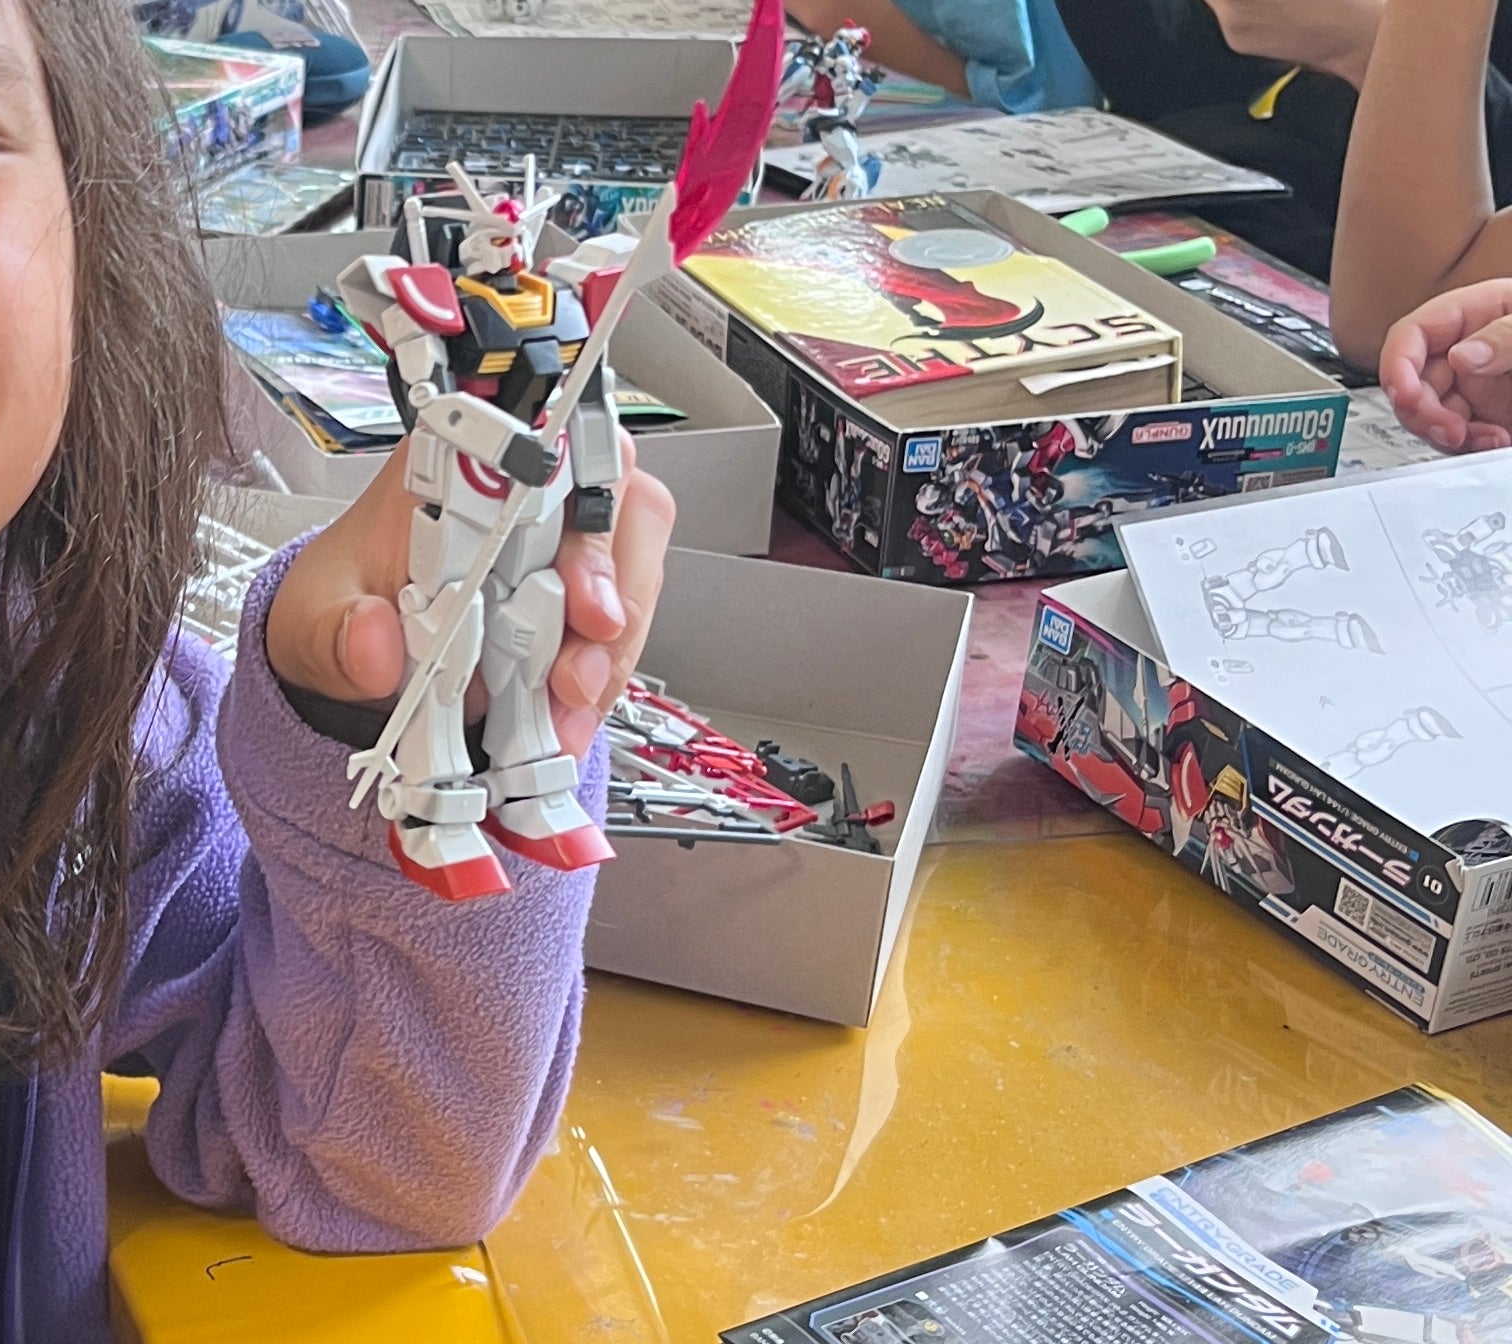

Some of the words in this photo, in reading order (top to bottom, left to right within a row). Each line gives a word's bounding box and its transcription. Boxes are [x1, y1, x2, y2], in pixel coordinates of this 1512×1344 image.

[838, 315, 1155, 381] SCYTHE
[914, 442, 936, 455] DAI
[1134, 425, 1191, 443] GUNPLA
[908, 455, 934, 465] BAN
[1043, 624, 1067, 647] BAN
[1049, 617, 1069, 633] DAI
[1268, 775, 1411, 887] ラーガンダム
[1423, 874, 1443, 895] 01
[1315, 927, 1368, 968] GRADE
[1365, 965, 1424, 1008] ENTRY
[1111, 1218, 1145, 1248] ENTRY
[1155, 1185, 1230, 1241] ENTRY
[1224, 1241, 1300, 1293] GRADE
[1118, 1203, 1303, 1338] ラーガンダム
